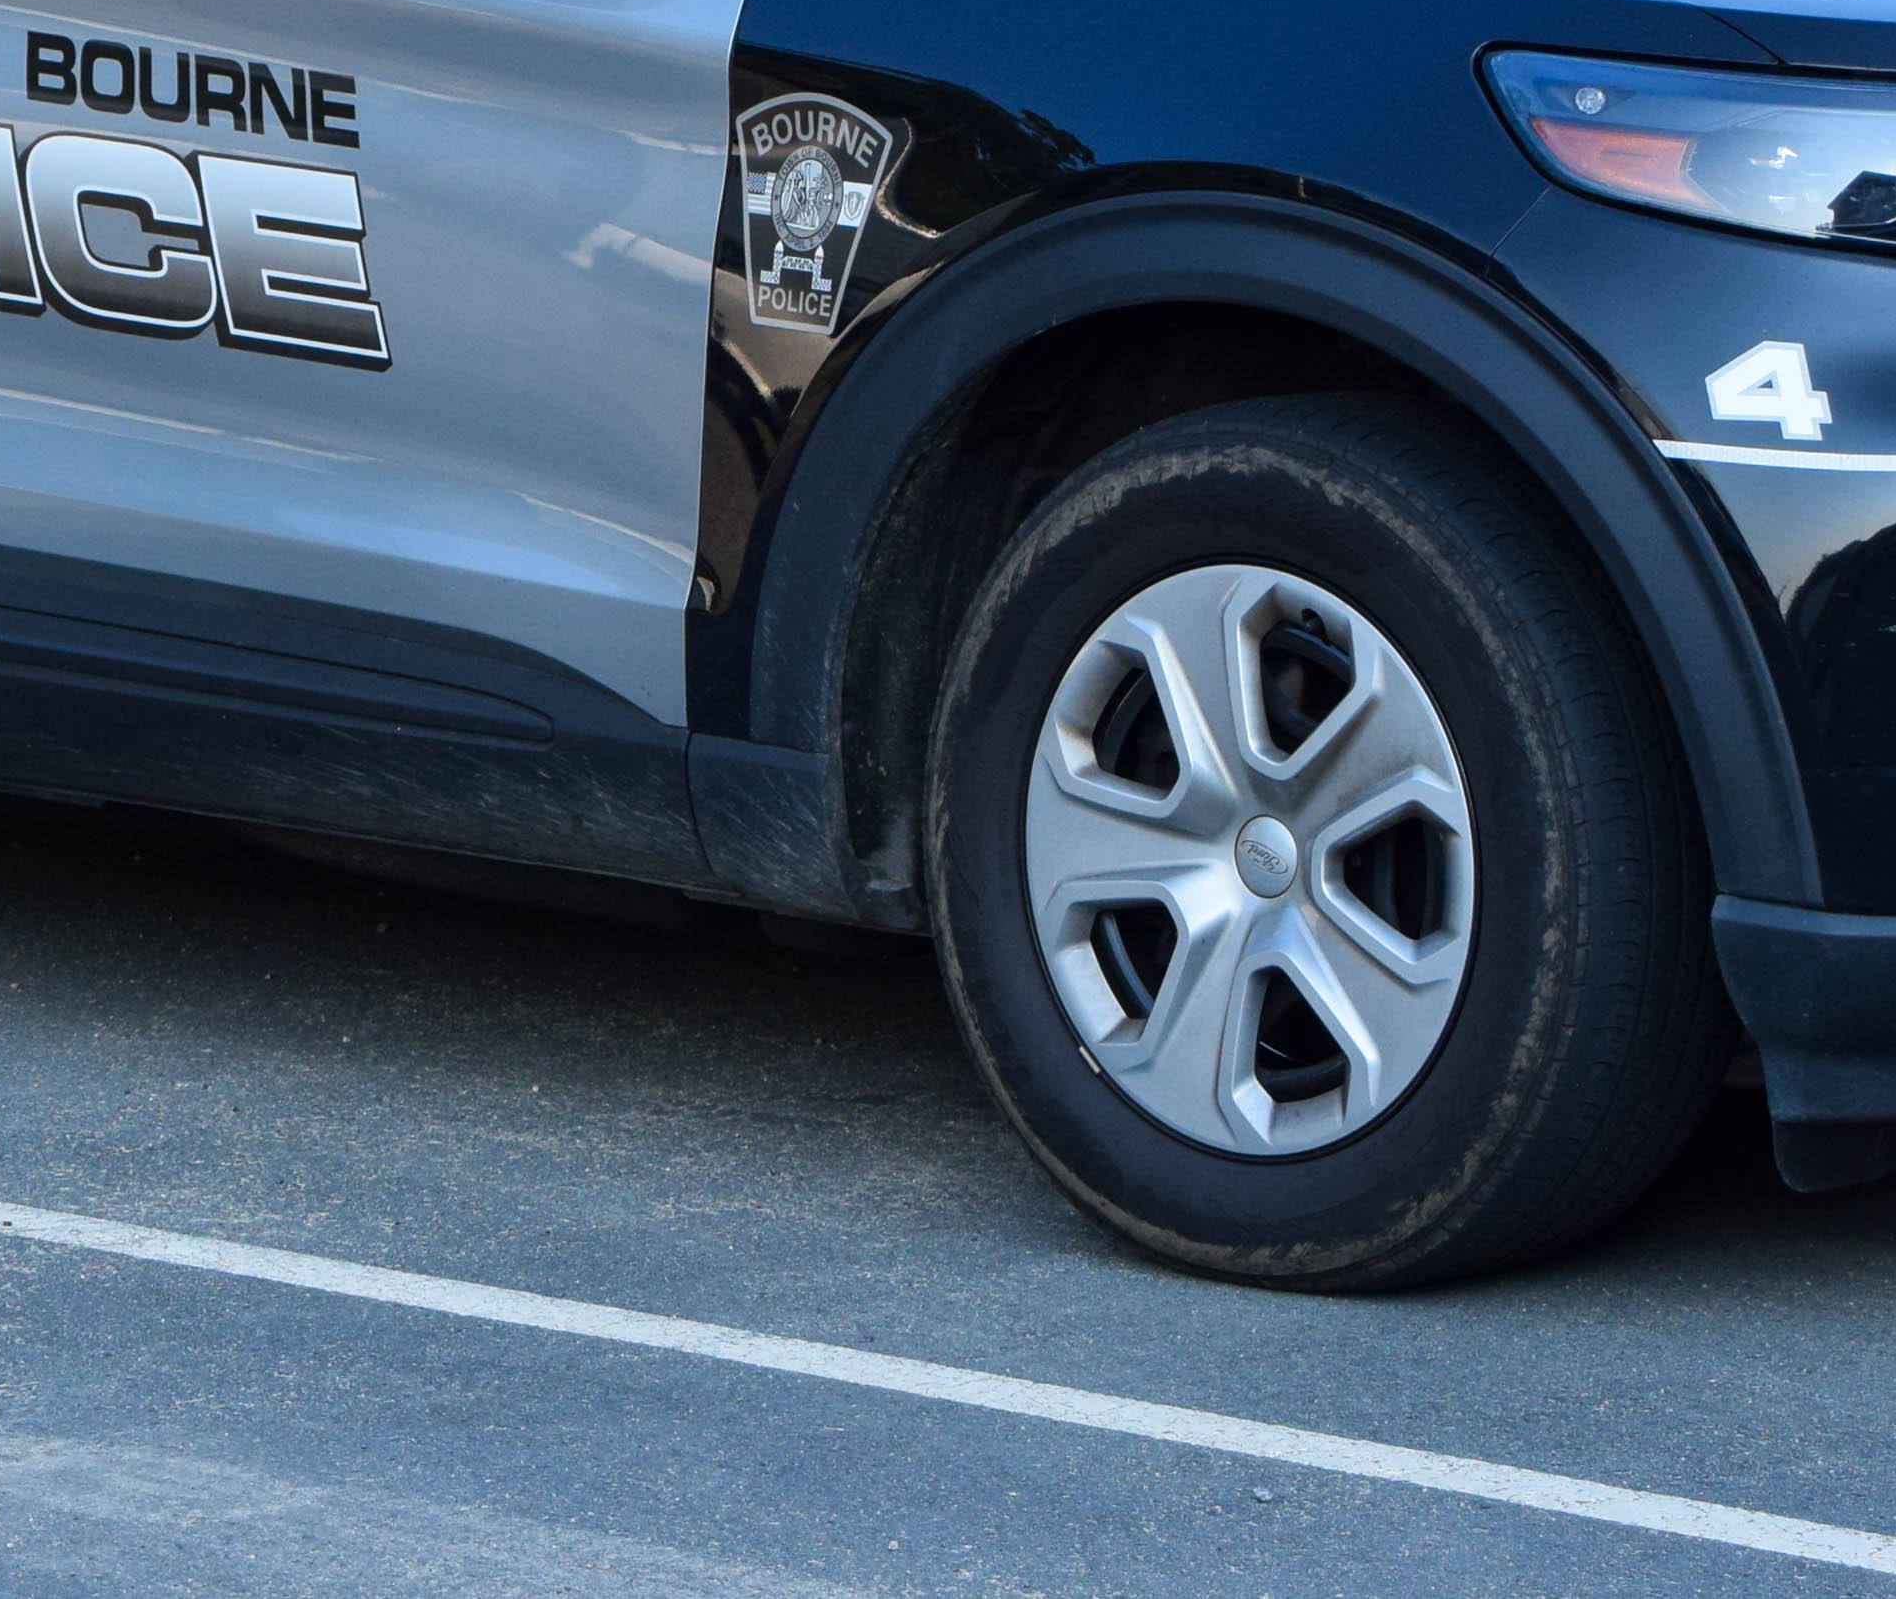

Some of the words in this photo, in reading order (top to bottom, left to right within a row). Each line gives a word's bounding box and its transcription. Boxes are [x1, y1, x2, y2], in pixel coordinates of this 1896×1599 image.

[26, 31, 361, 148] BOURNE
[751, 110, 878, 168] BOURNE
[757, 285, 832, 317] POLICE
[1705, 340, 1833, 441] 4
